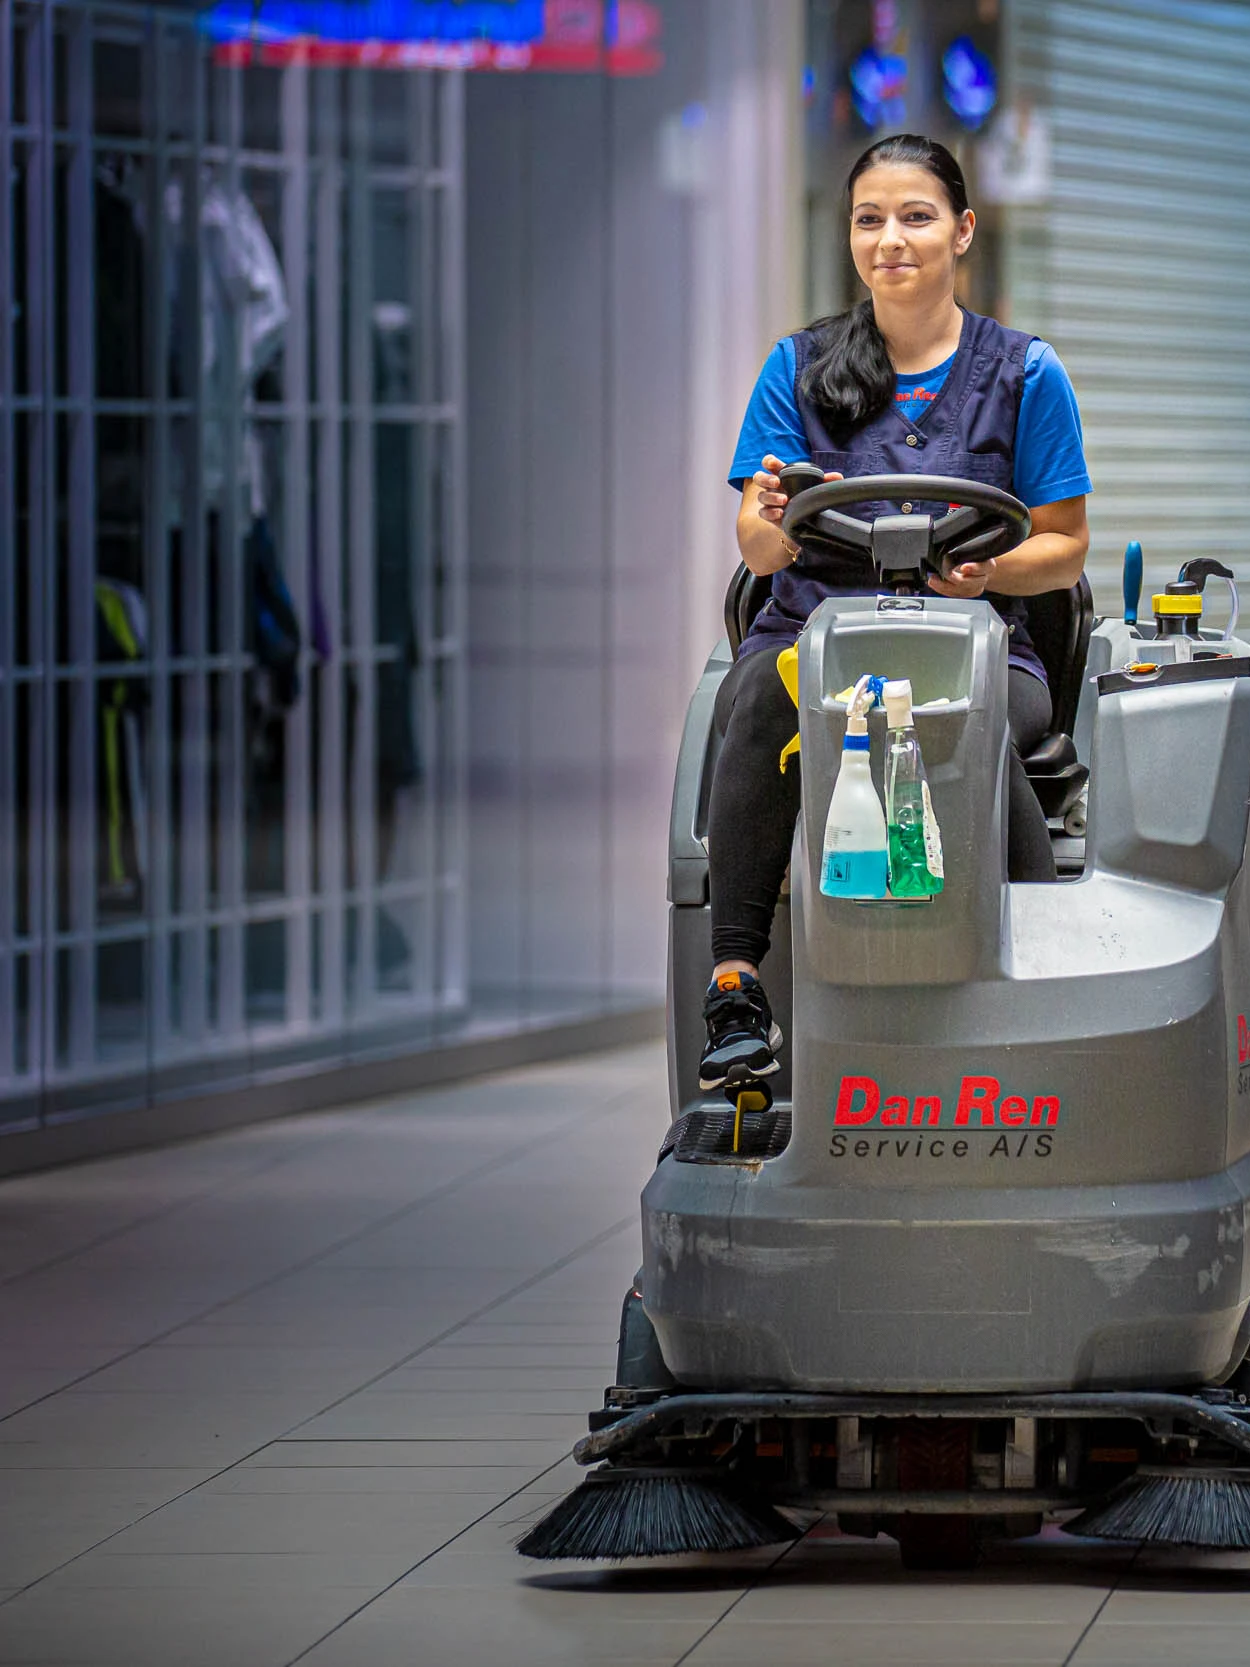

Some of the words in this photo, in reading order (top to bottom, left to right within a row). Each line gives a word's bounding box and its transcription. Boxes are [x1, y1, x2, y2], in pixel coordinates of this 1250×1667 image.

[895, 392, 911, 401] an
[833, 1075, 942, 1127] Dan
[953, 1075, 1061, 1127] Ren
[829, 1133, 969, 1158] Service
[988, 1133, 1053, 1158] A/S
